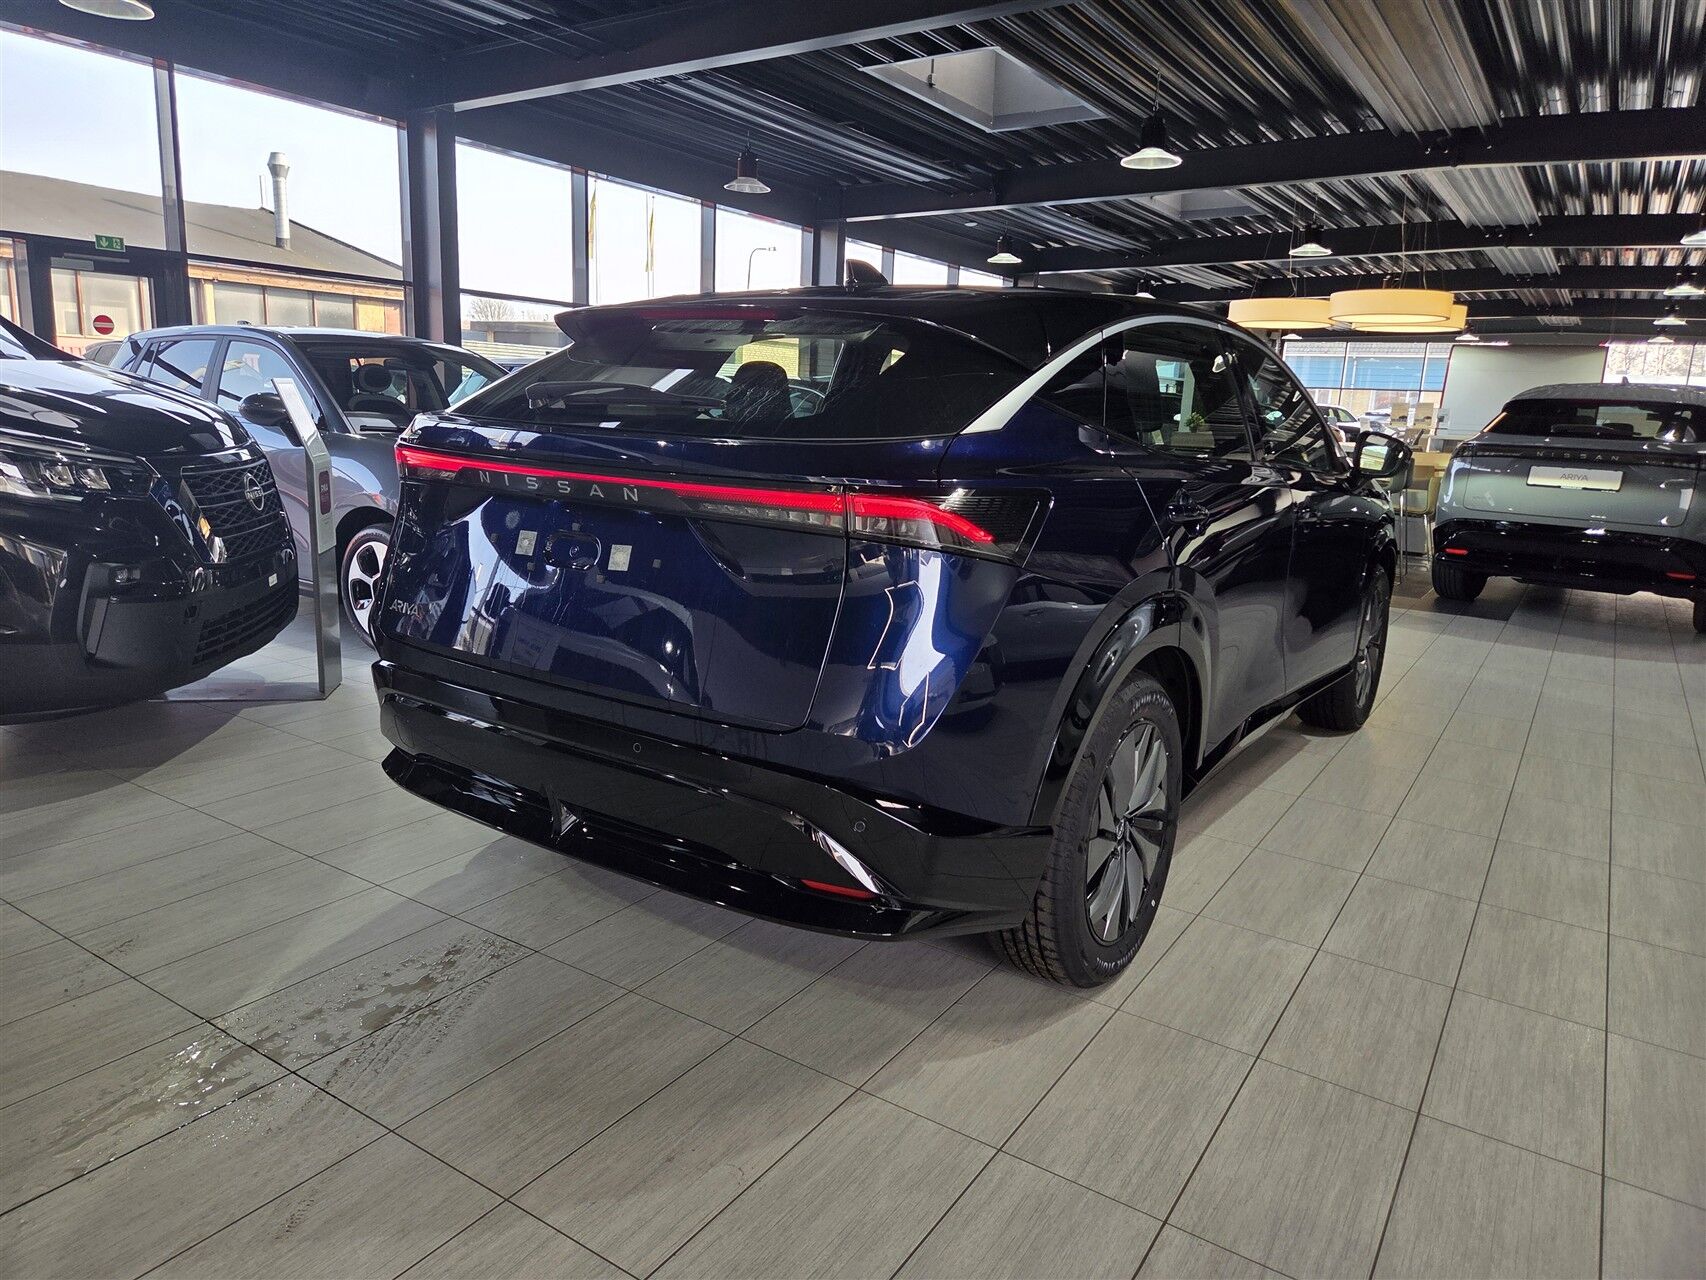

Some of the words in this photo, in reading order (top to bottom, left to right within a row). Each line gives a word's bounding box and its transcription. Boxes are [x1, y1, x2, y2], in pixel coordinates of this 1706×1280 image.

[1536, 451, 1620, 461] NISSAN
[1560, 473, 1589, 482] ARIYA
[479, 470, 639, 502] NISSAN
[389, 599, 419, 615] ARIYA
